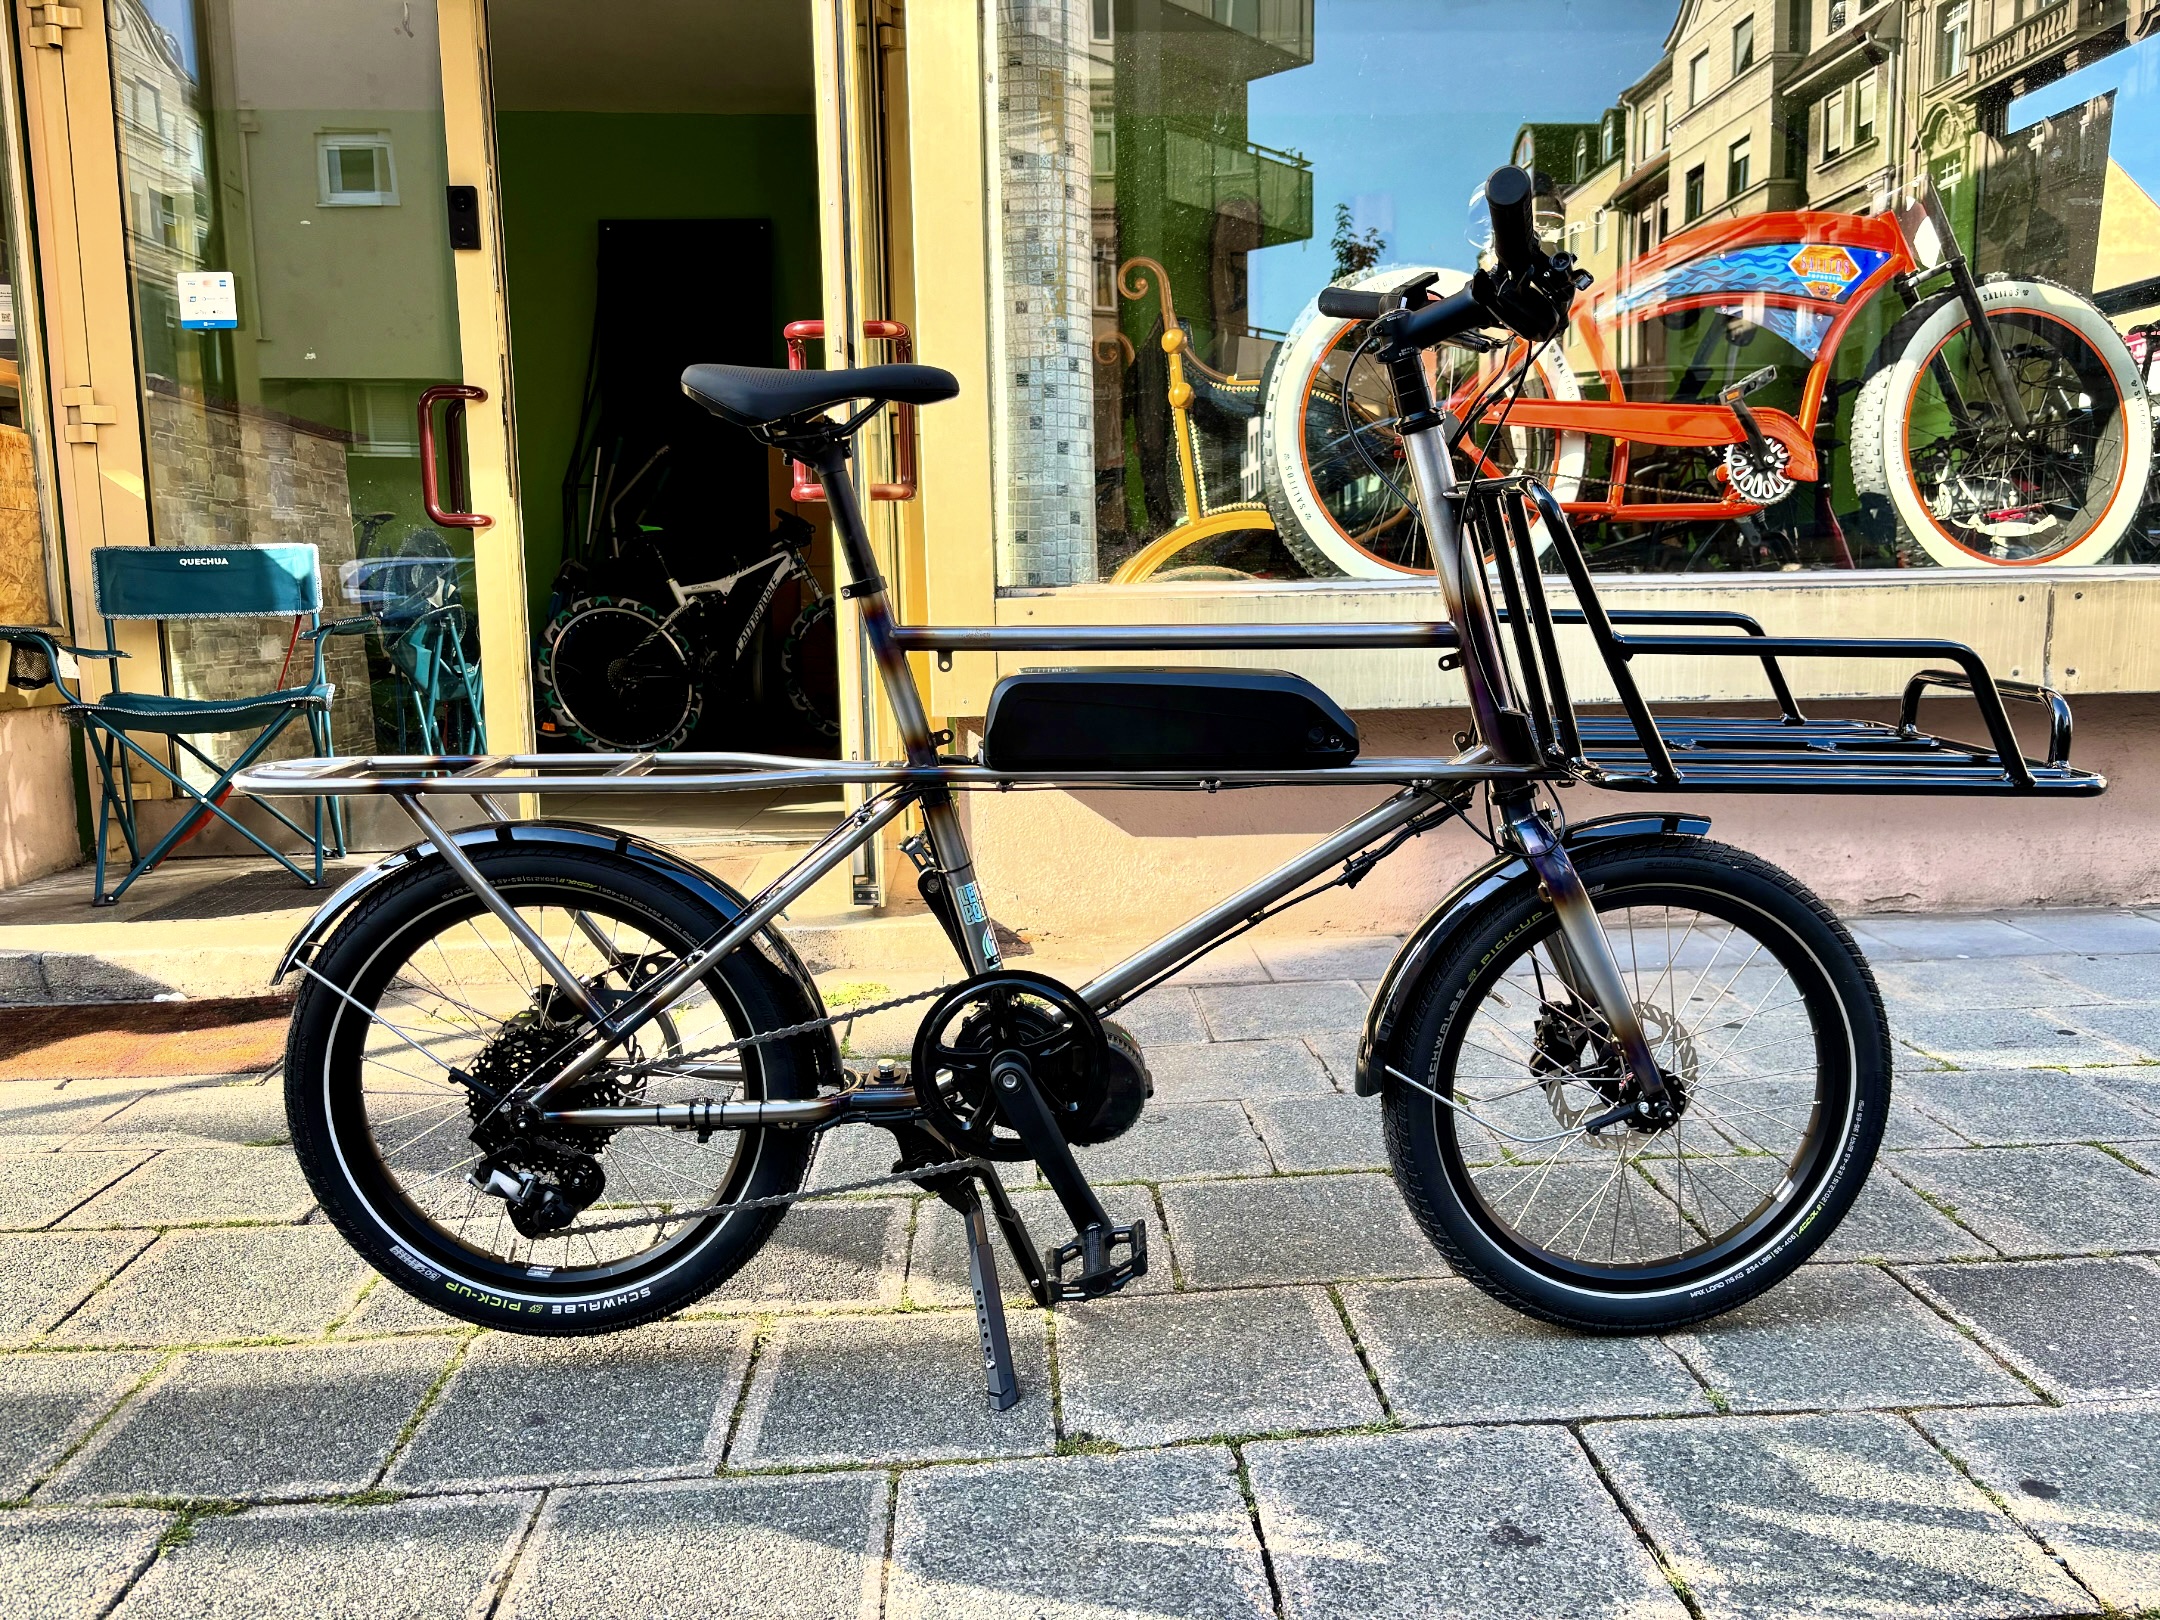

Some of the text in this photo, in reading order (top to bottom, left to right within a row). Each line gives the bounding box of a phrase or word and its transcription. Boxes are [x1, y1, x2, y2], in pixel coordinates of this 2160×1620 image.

[1801, 256, 1850, 274] SALITOS
[1982, 288, 2019, 302] SALITOS
[179, 557, 229, 567] QUECHUA
[1427, 911, 1543, 1086] SCHWALBE PICK-UP
[1744, 1263, 1759, 1274] 254
[1772, 1233, 1796, 1254] 55-406
[445, 1282, 652, 1315] SCHWALBE PICK-UP
